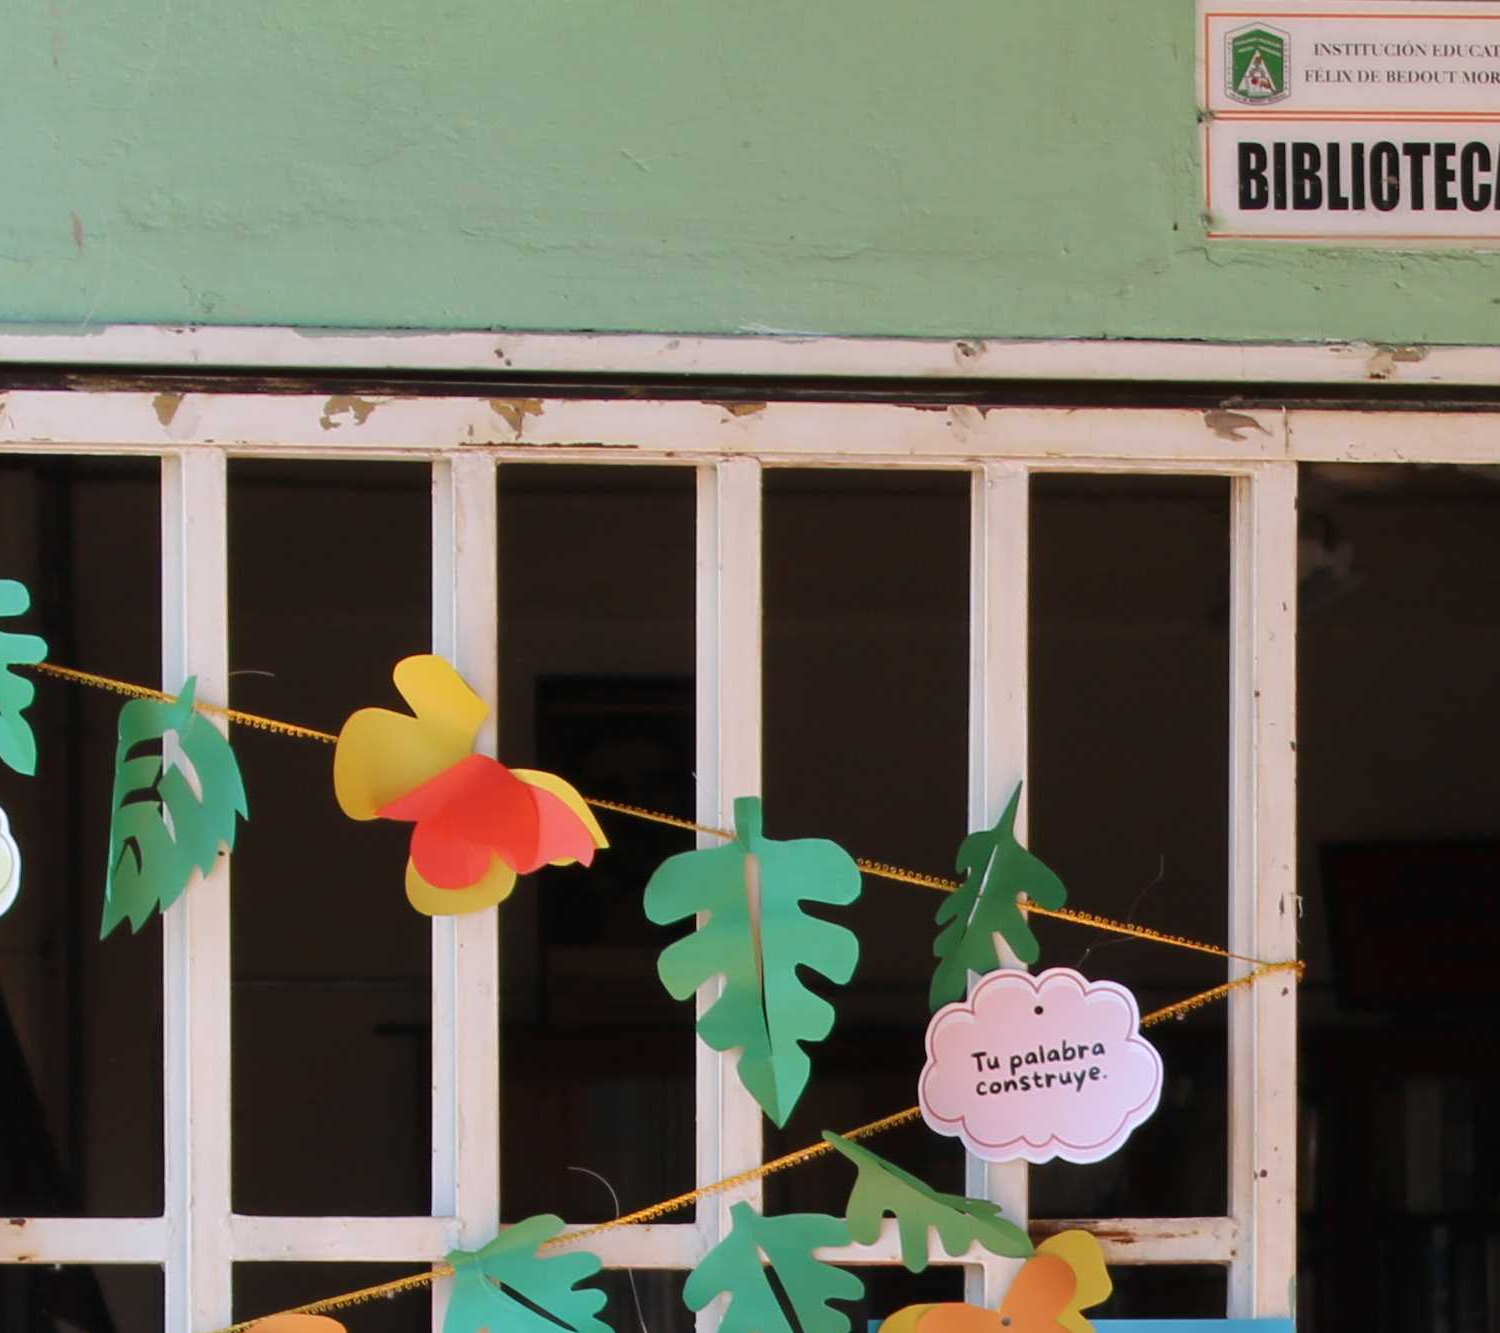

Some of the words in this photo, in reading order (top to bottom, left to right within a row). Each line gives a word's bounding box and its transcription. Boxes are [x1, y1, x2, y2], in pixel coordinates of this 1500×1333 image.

[1314, 40, 1427, 57] INSTITUCIÓN
[1357, 69, 1381, 84] DE
[1386, 70, 1459, 84] BEDOUT
[972, 1051, 1000, 1073] Tu
[1009, 1040, 1105, 1075] palabra
[975, 1065, 1107, 1096] construye.
